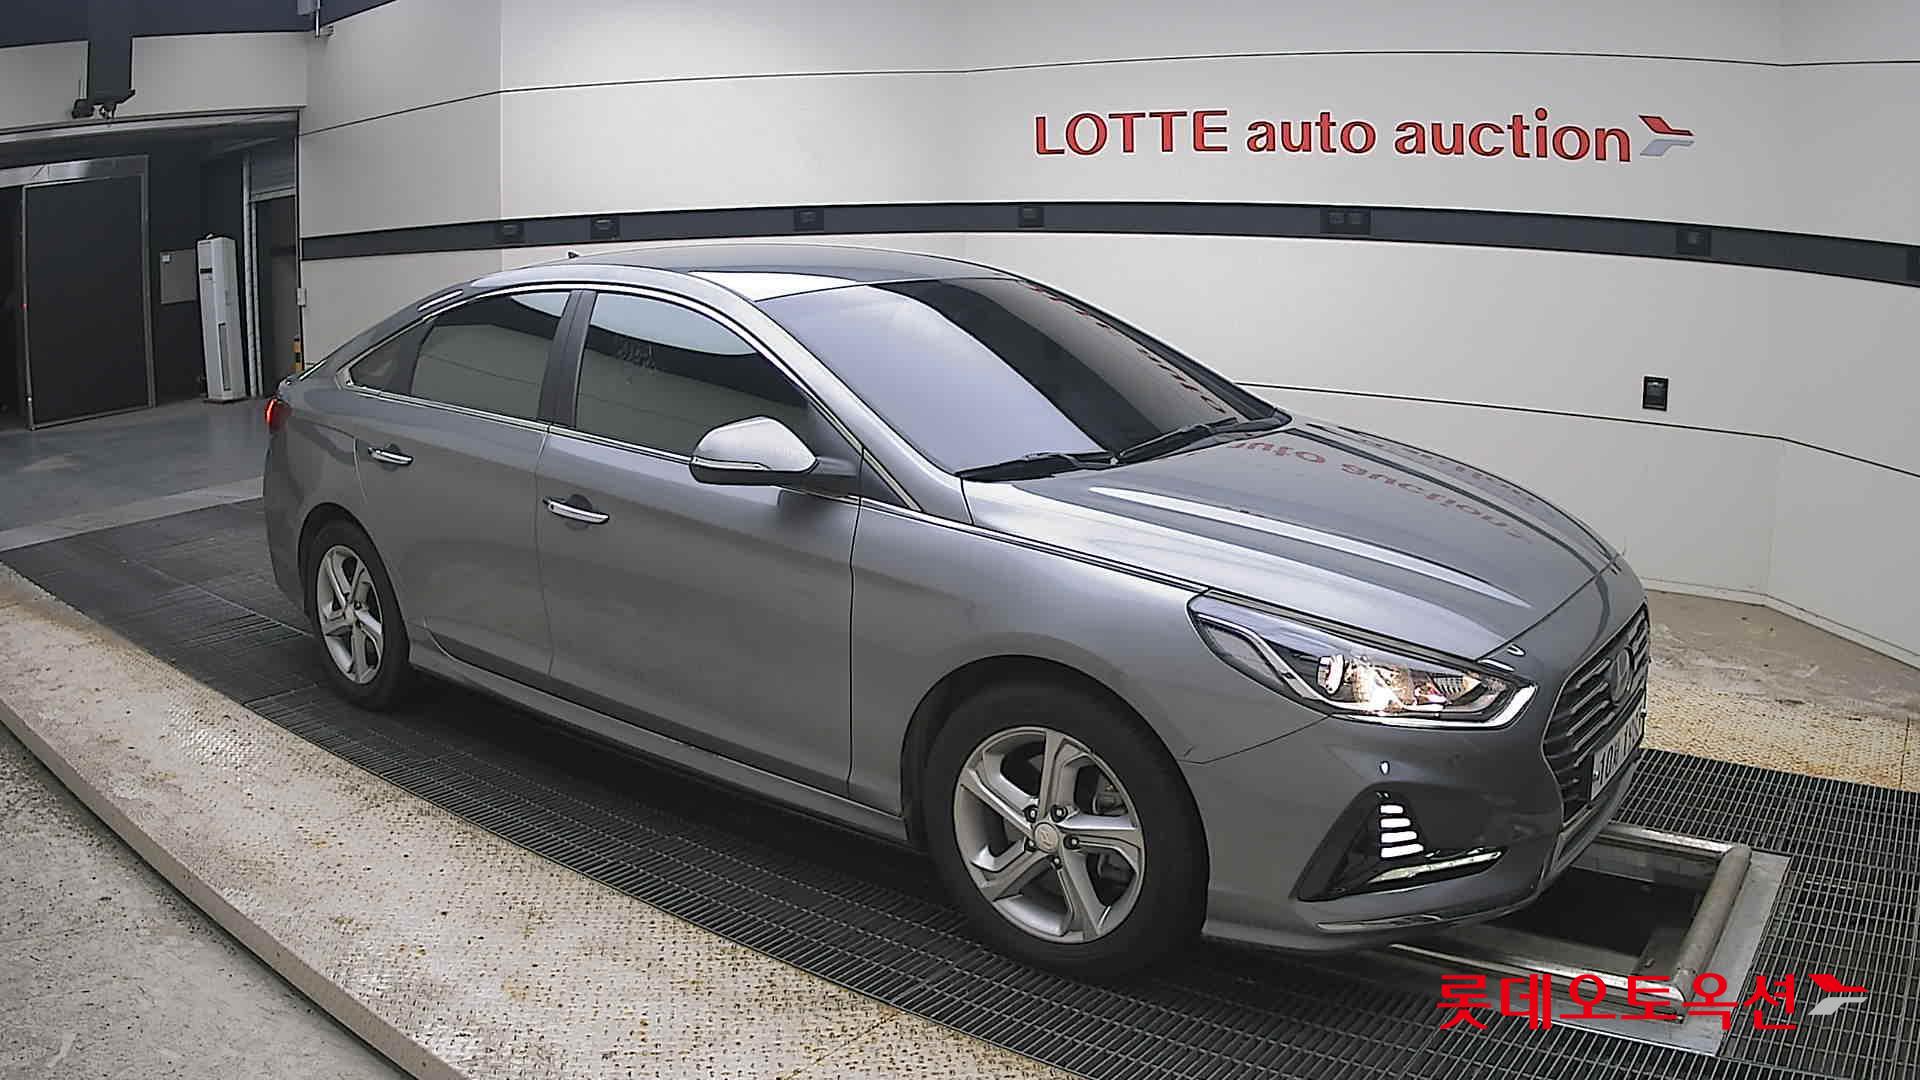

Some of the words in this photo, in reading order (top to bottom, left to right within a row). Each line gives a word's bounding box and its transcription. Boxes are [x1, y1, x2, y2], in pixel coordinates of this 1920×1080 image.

[1034, 109, 1228, 156] LOTTE
[1246, 111, 1377, 154] auto
[1394, 107, 1633, 163] auction
